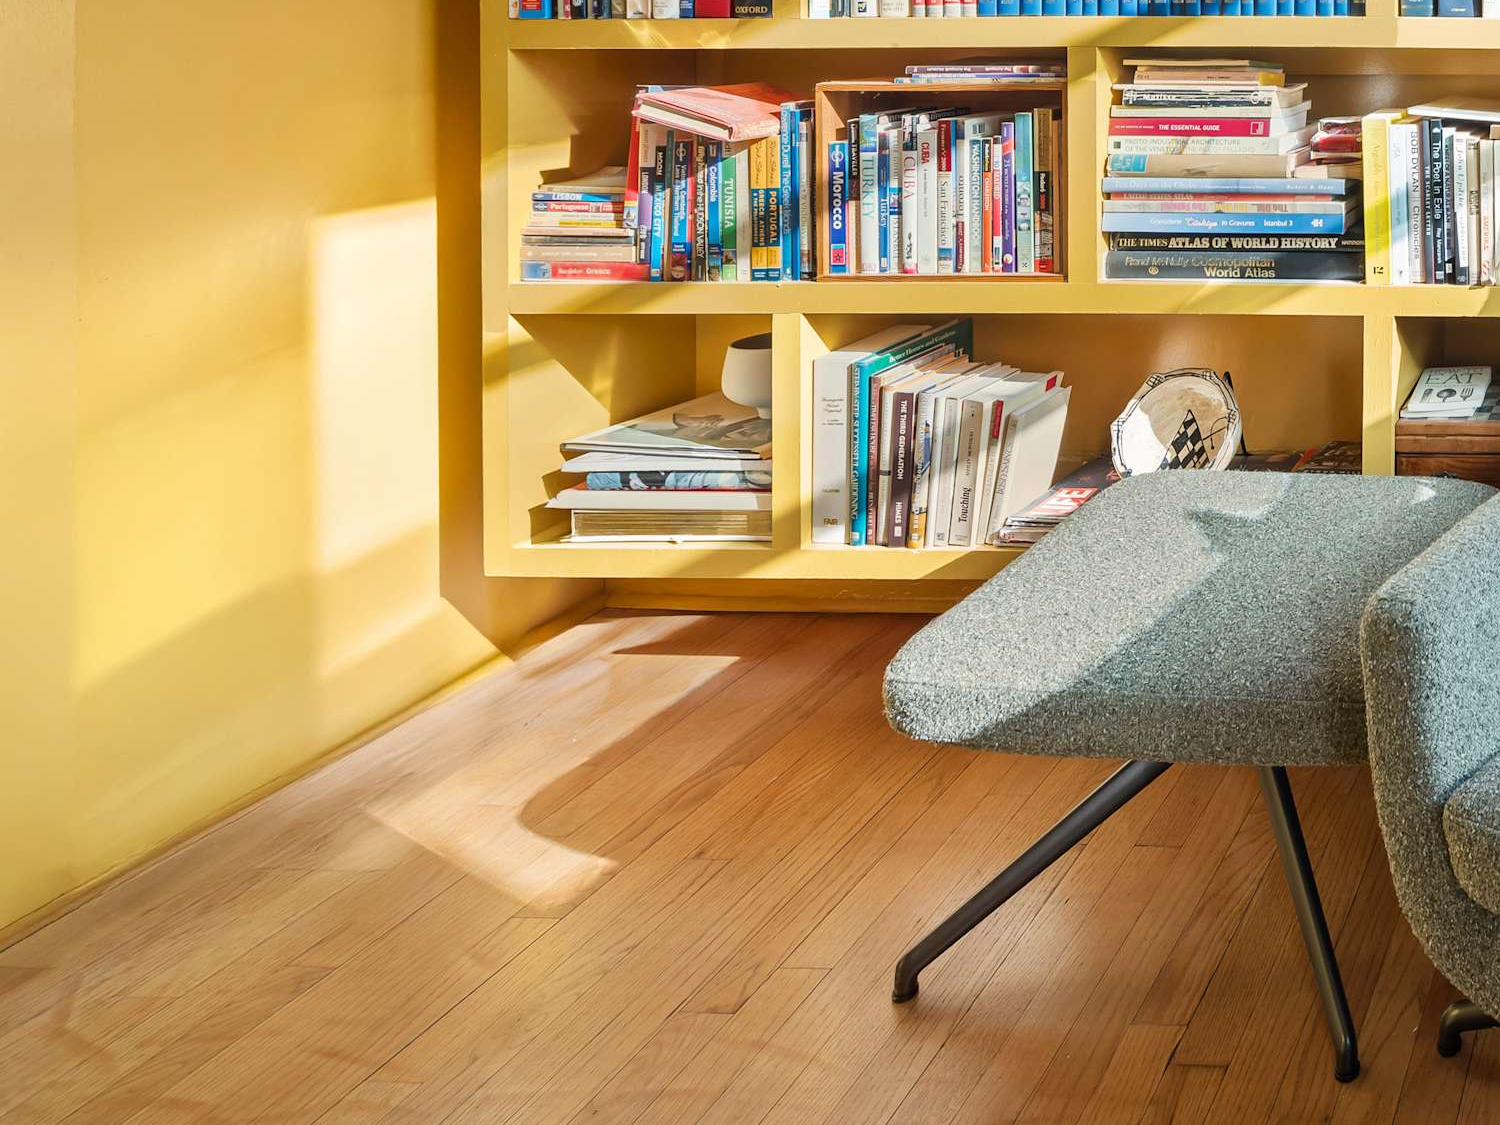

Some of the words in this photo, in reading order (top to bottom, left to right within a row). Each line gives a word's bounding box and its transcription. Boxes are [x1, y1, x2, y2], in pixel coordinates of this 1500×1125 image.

[735, 6, 768, 14] OXFORD
[1203, 124, 1220, 132] GUIDE
[921, 141, 930, 164] CUBA
[1410, 132, 1419, 154] BOB
[1433, 141, 1441, 158] The
[903, 155, 915, 199] CUBA
[1410, 157, 1420, 192] DYLAN
[1433, 161, 1441, 183] Poet
[709, 165, 717, 202] Colombia
[861, 156, 875, 219] TURKEY
[940, 180, 949, 198] San
[1433, 185, 1441, 195] in
[724, 178, 733, 228] TUNISIA
[833, 171, 844, 229] Morocco
[1433, 197, 1441, 219] Exile
[769, 191, 777, 243] PORTUGAL
[940, 200, 949, 245] Francisco
[1119, 238, 1138, 247] THE
[1139, 238, 1168, 247] TIMES
[1169, 238, 1209, 248] ATLAS
[1212, 238, 1228, 248] OF
[1231, 238, 1278, 248] WORLD
[1281, 238, 1338, 248] HISTORY
[1412, 205, 1421, 259] Chronicles
[1191, 258, 1275, 269] Cosmopolitan
[1204, 267, 1240, 278] World
[1244, 267, 1275, 278] Atlas
[899, 399, 907, 412] THE
[898, 413, 907, 434] THIRD
[896, 434, 906, 479] GENERATION
[894, 501, 903, 524] HIMES
[958, 486, 971, 523] Touching
